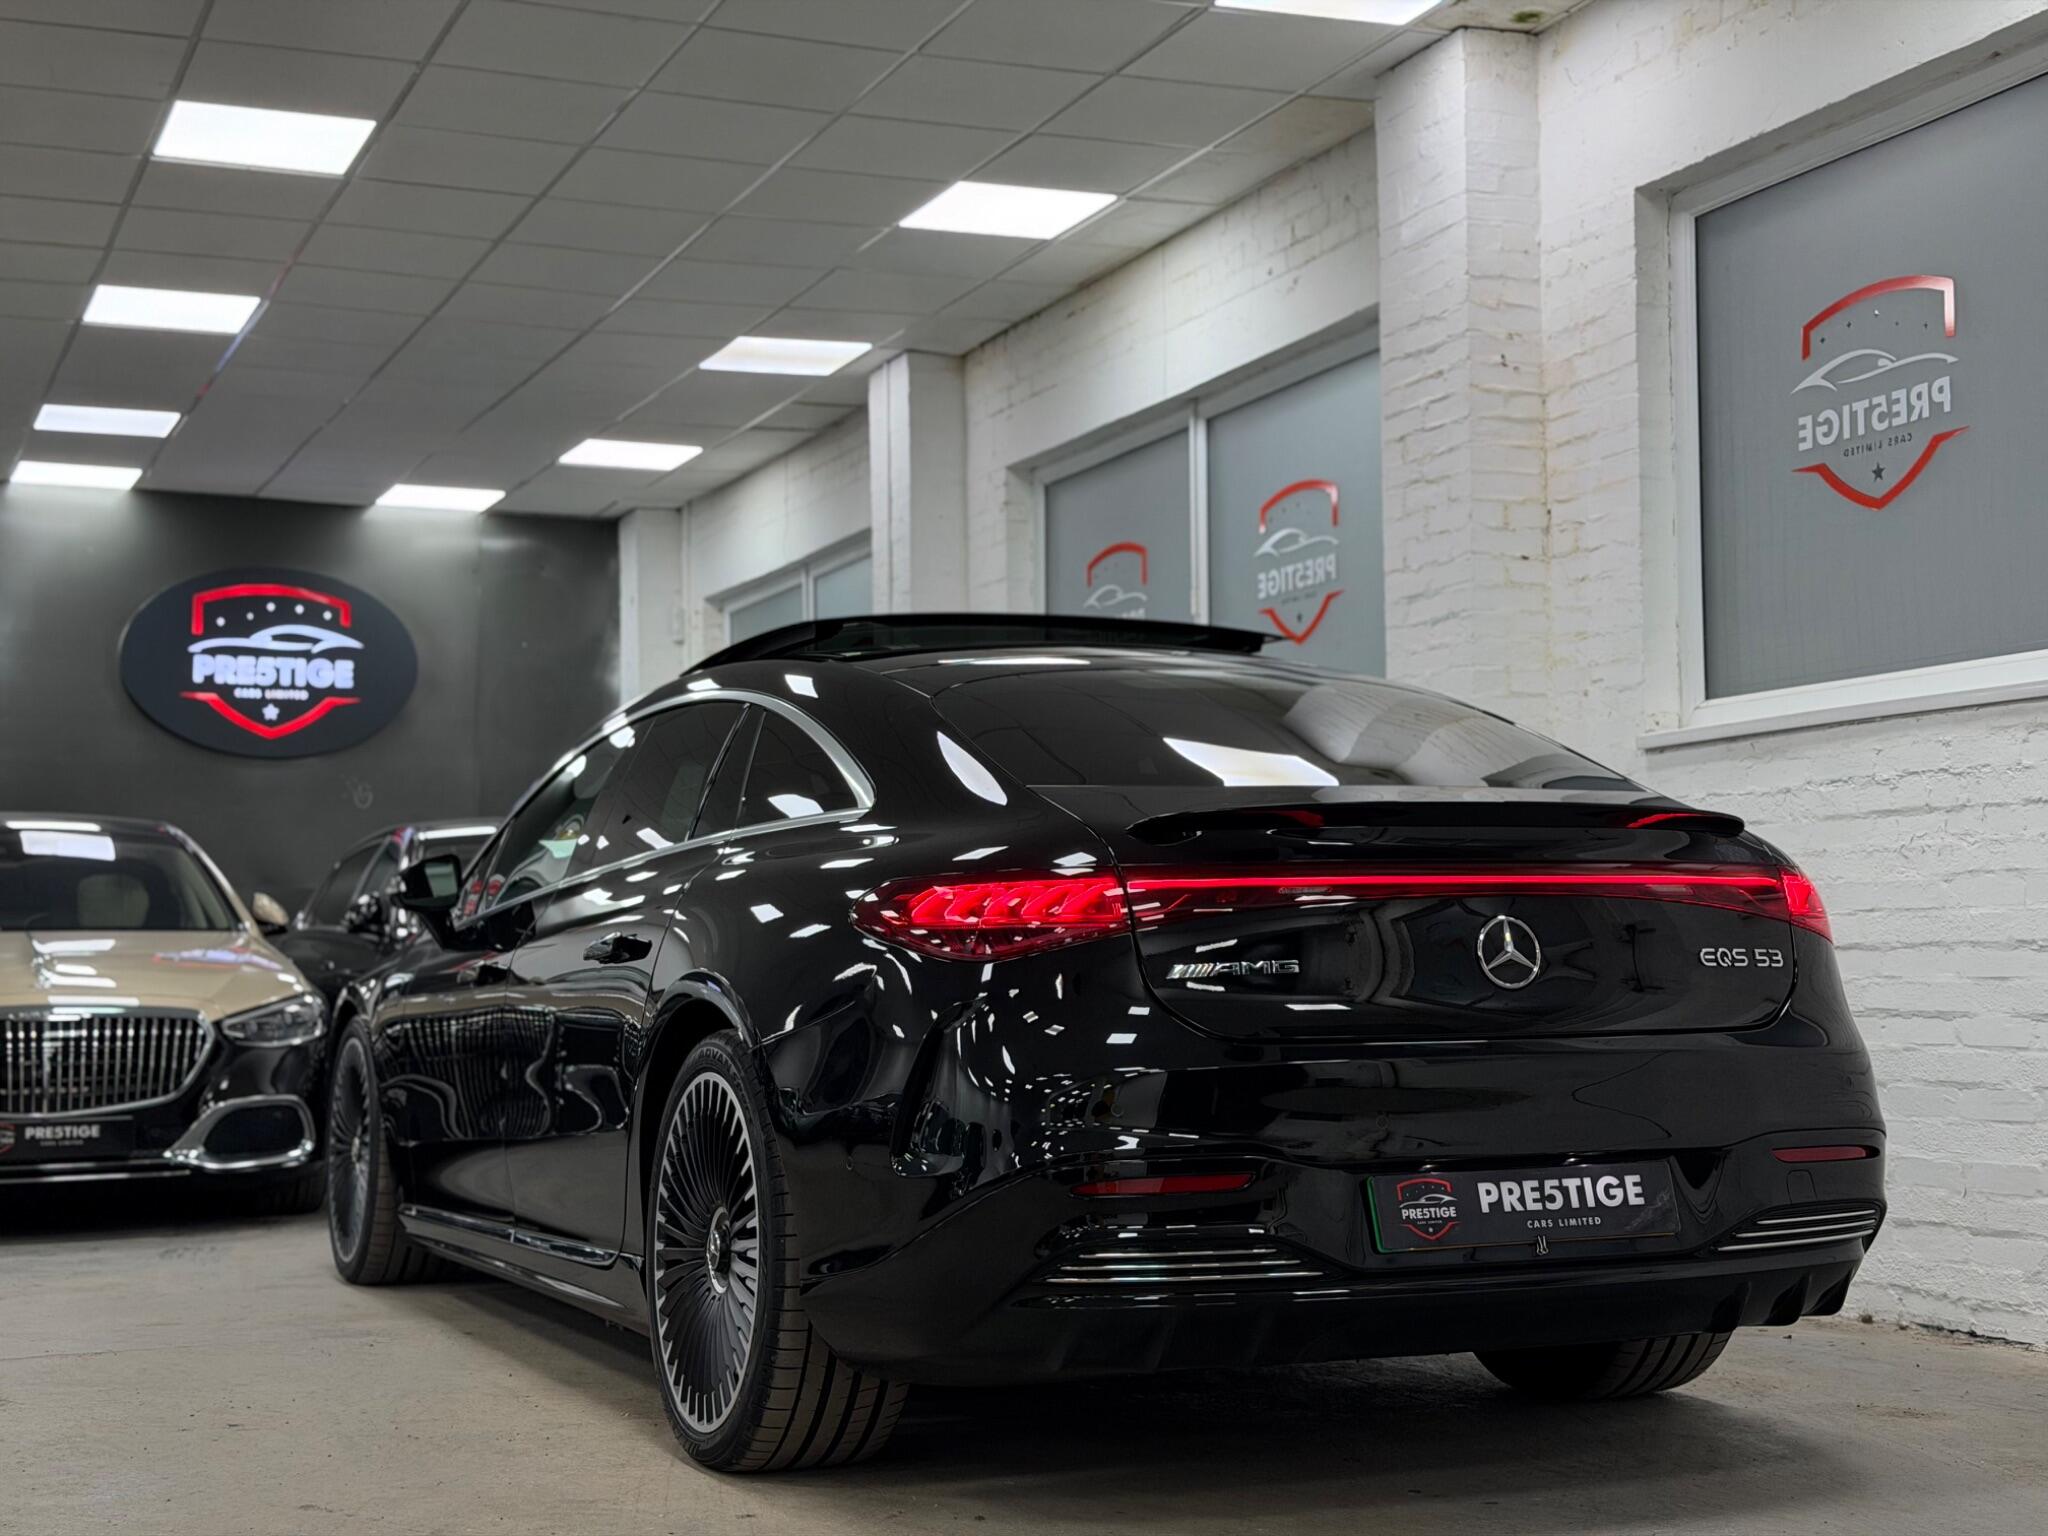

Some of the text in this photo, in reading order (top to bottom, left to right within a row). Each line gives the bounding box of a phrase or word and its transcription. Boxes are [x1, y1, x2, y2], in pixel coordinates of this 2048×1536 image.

[1700, 947, 1784, 967] EQS 53
[1209, 960, 1300, 977] AMG
[1527, 1216, 1602, 1228] CARS LIMITED
